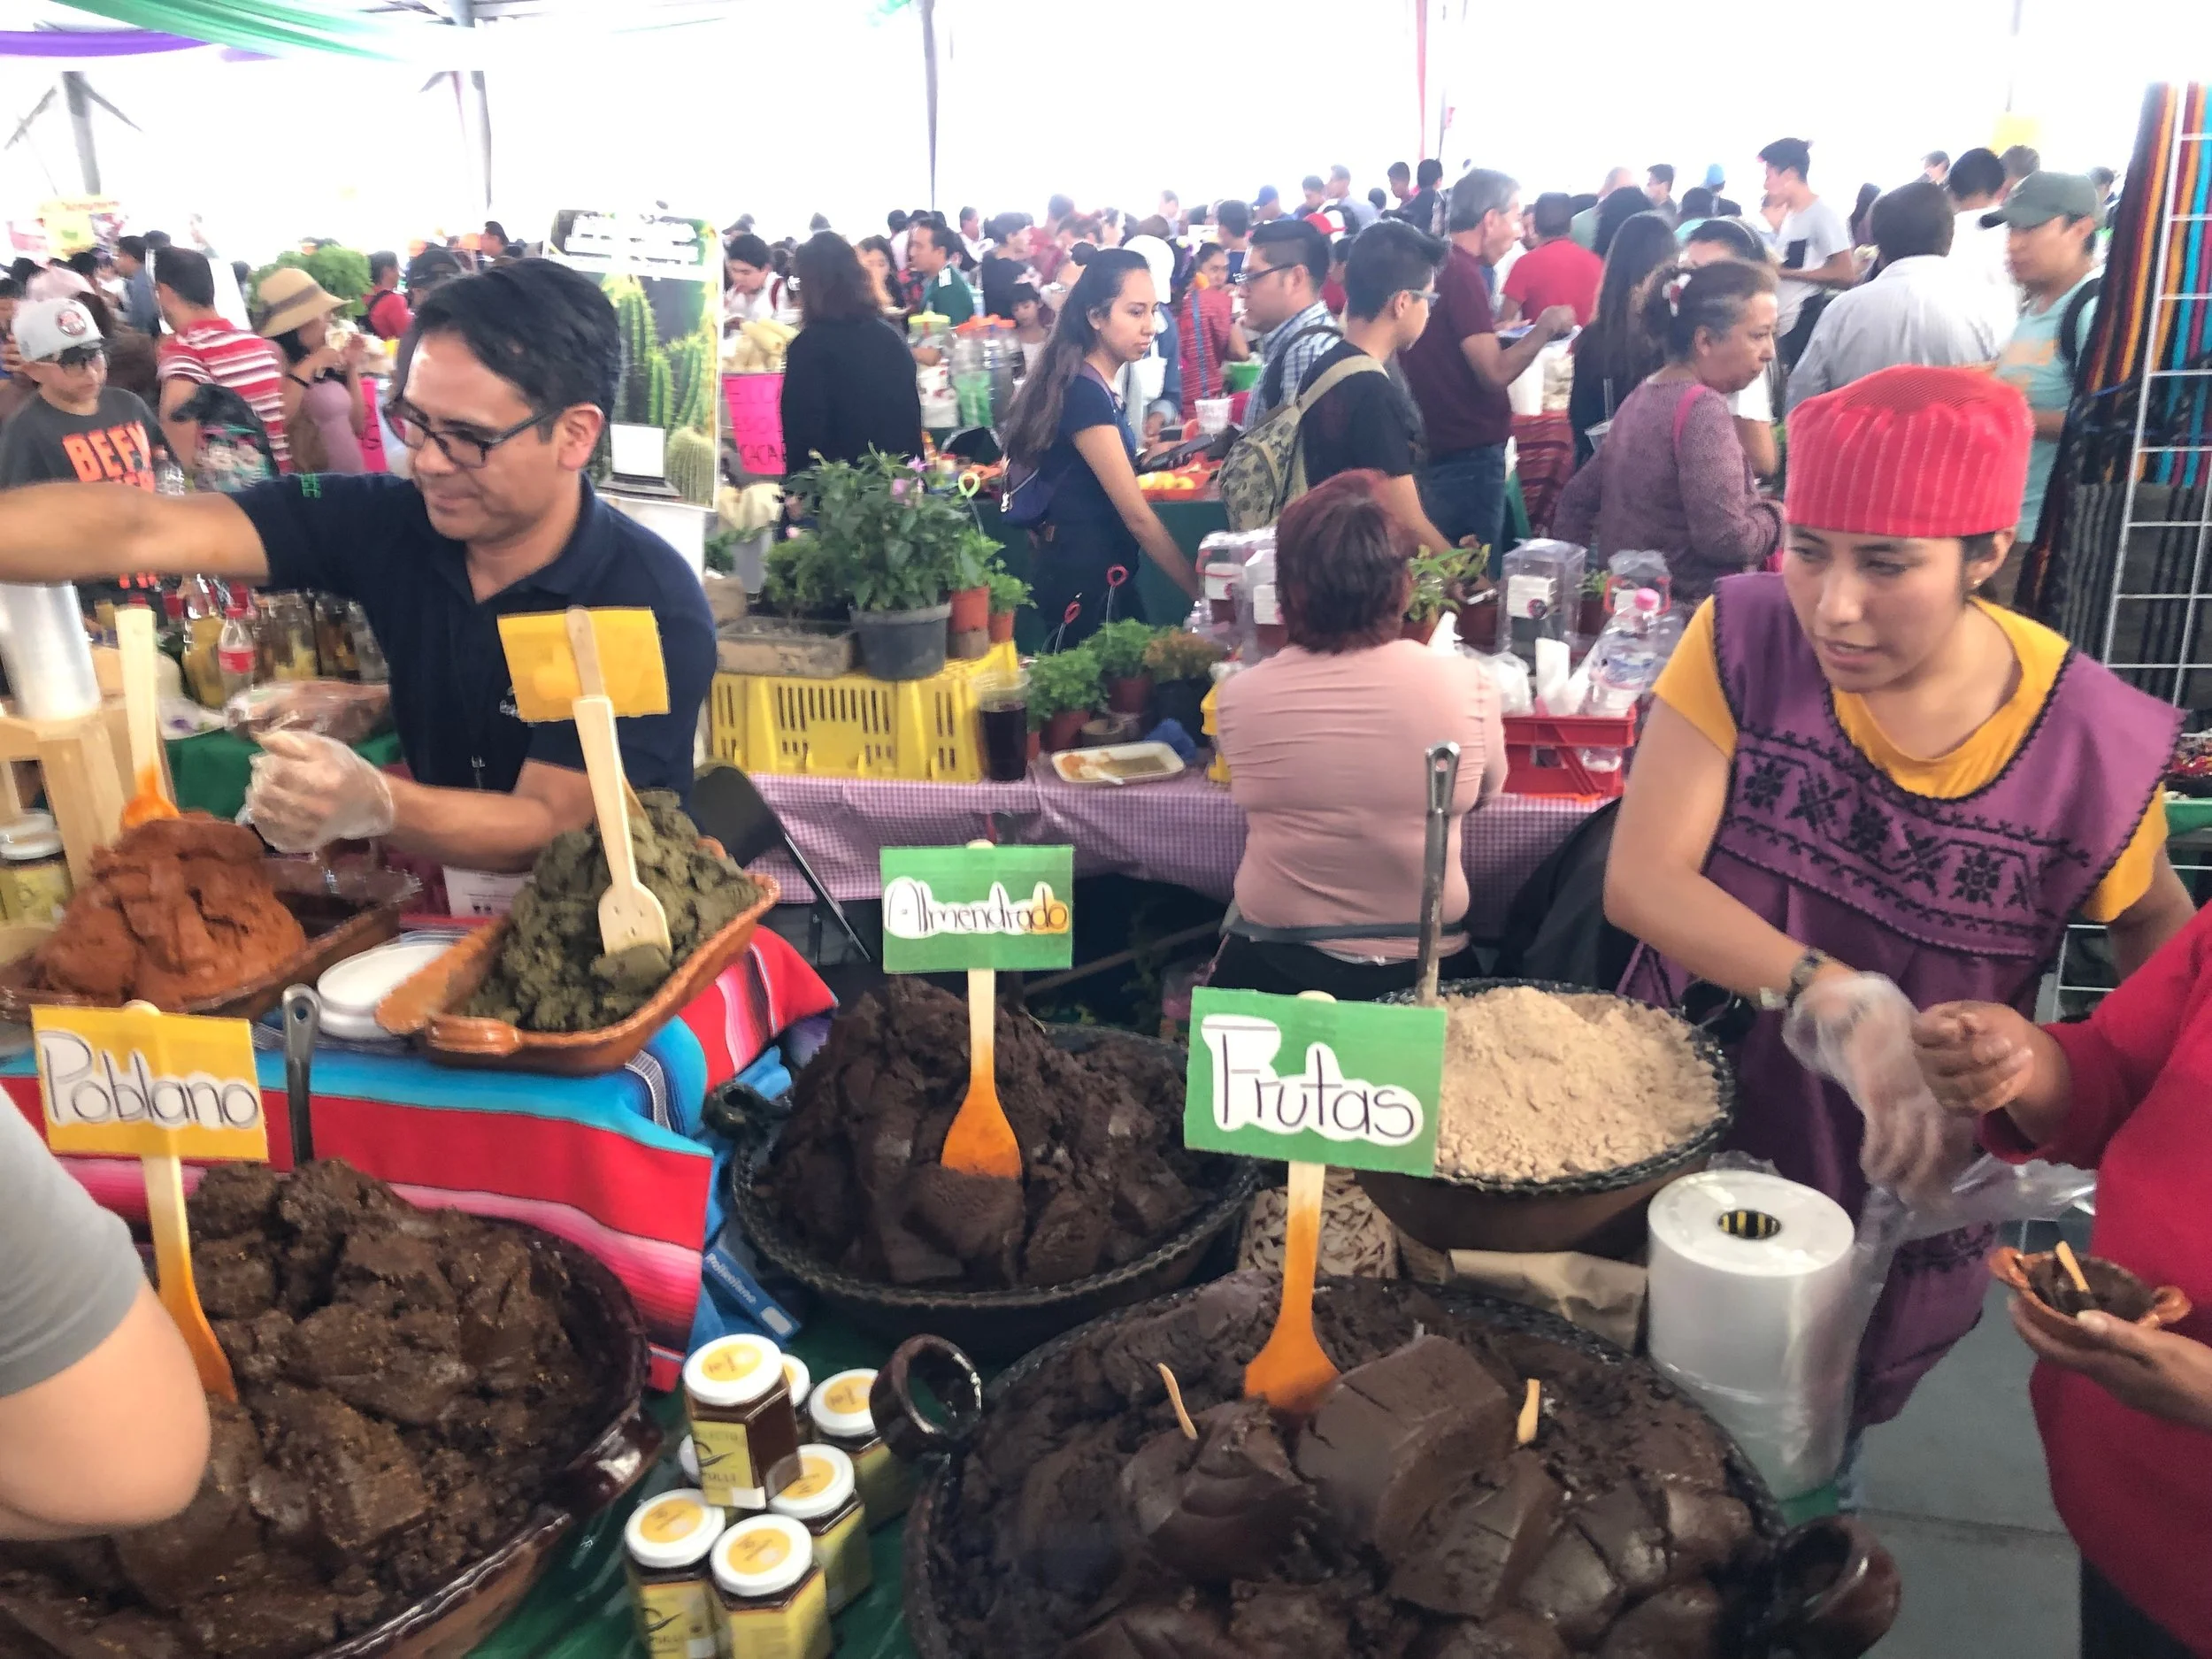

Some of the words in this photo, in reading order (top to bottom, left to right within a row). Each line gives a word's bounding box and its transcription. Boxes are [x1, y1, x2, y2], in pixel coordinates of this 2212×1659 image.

[887, 881, 1068, 933] Almendrado
[35, 1029, 259, 1130] Poblano
[1201, 1024, 1415, 1139] Frutas
